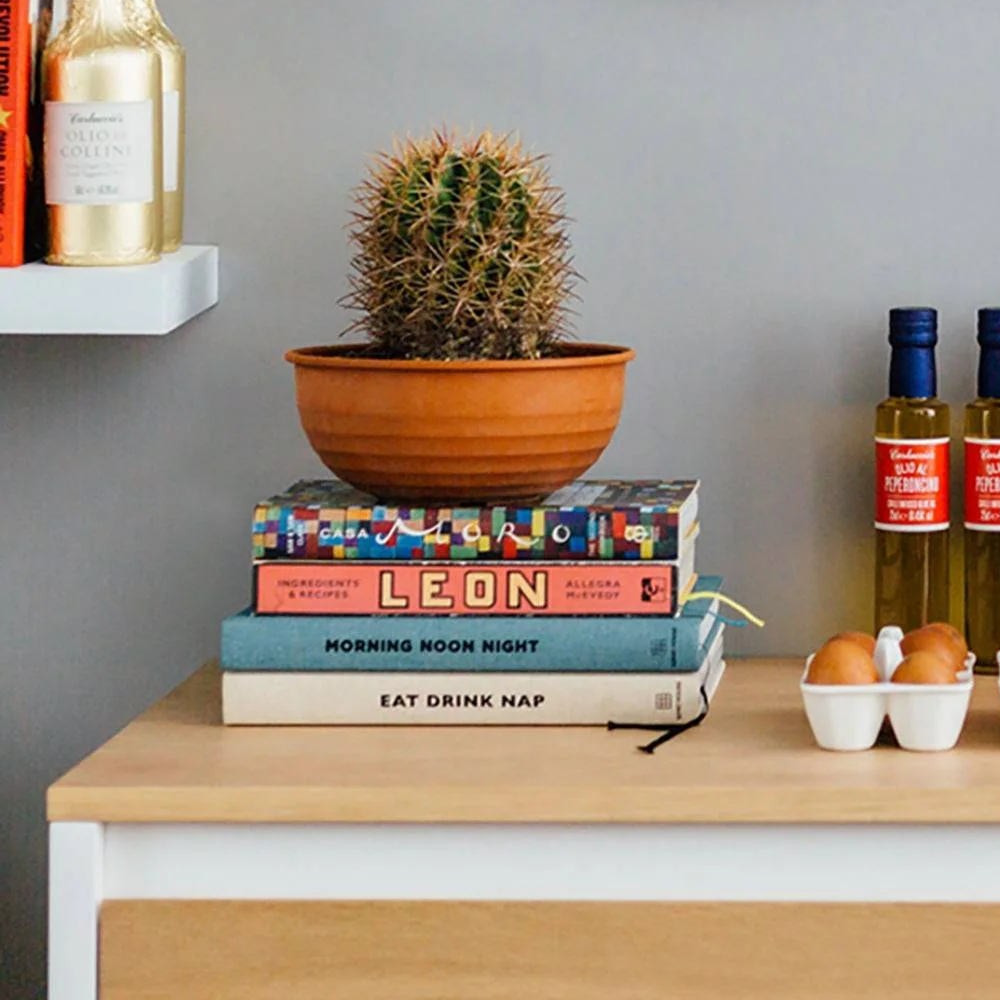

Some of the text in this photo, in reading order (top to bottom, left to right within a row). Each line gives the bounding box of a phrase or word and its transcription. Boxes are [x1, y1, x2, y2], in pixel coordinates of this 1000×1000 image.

[66, 130, 109, 142] OLIO
[320, 528, 369, 540] CASA
[278, 579, 360, 588] INGREDIENTS
[565, 579, 621, 589] ALLEGRA
[300, 590, 349, 599] RECIPES
[379, 570, 548, 610] LEON
[325, 639, 539, 654] MORNING NOON NIGHT
[380, 694, 545, 708] EAT DRINK NAP
